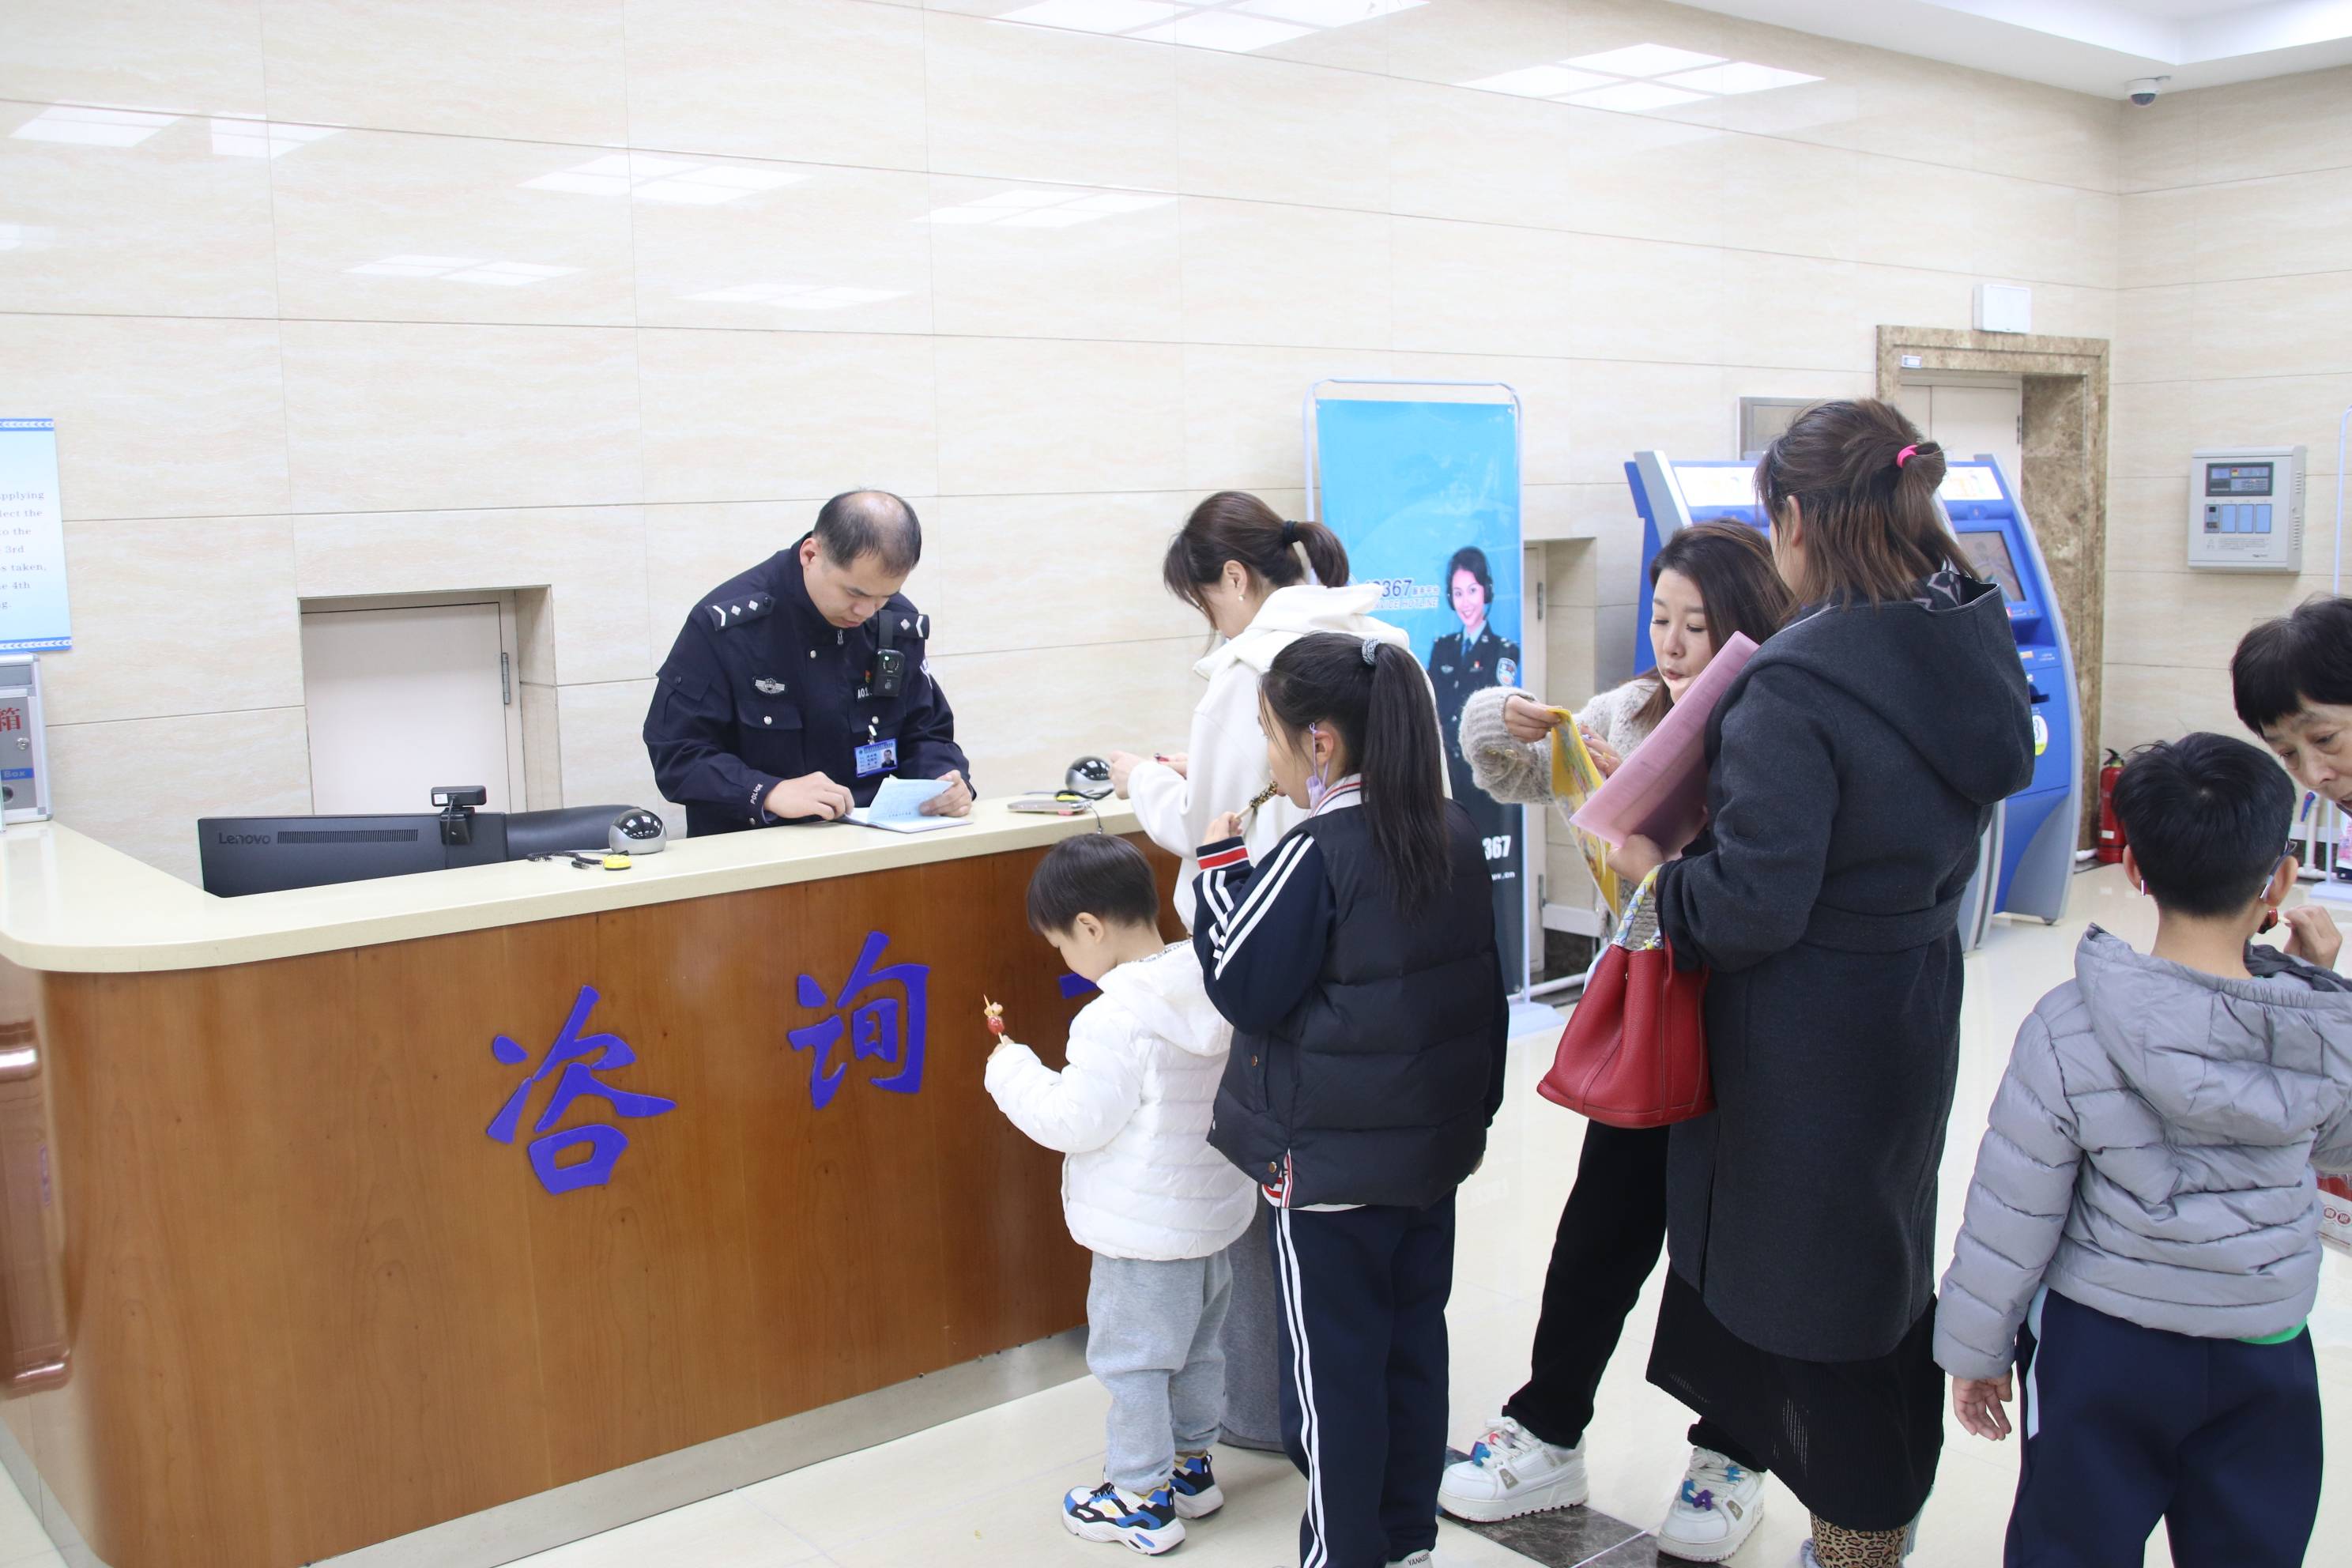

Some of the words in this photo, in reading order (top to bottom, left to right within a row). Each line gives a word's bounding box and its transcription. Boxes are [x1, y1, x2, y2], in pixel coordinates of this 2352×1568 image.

[0, 491, 45, 501] pplying
[24, 509, 43, 518] the
[13, 527, 32, 536] the
[6, 545, 24, 553] 3rd
[13, 581, 31, 590] 4th
[0, 707, 21, 732] 箱
[4, 770, 26, 778] Box
[749, 783, 763, 805] POLICE
[218, 831, 272, 845] Lenovo
[486, 930, 1097, 1197] 咨询
